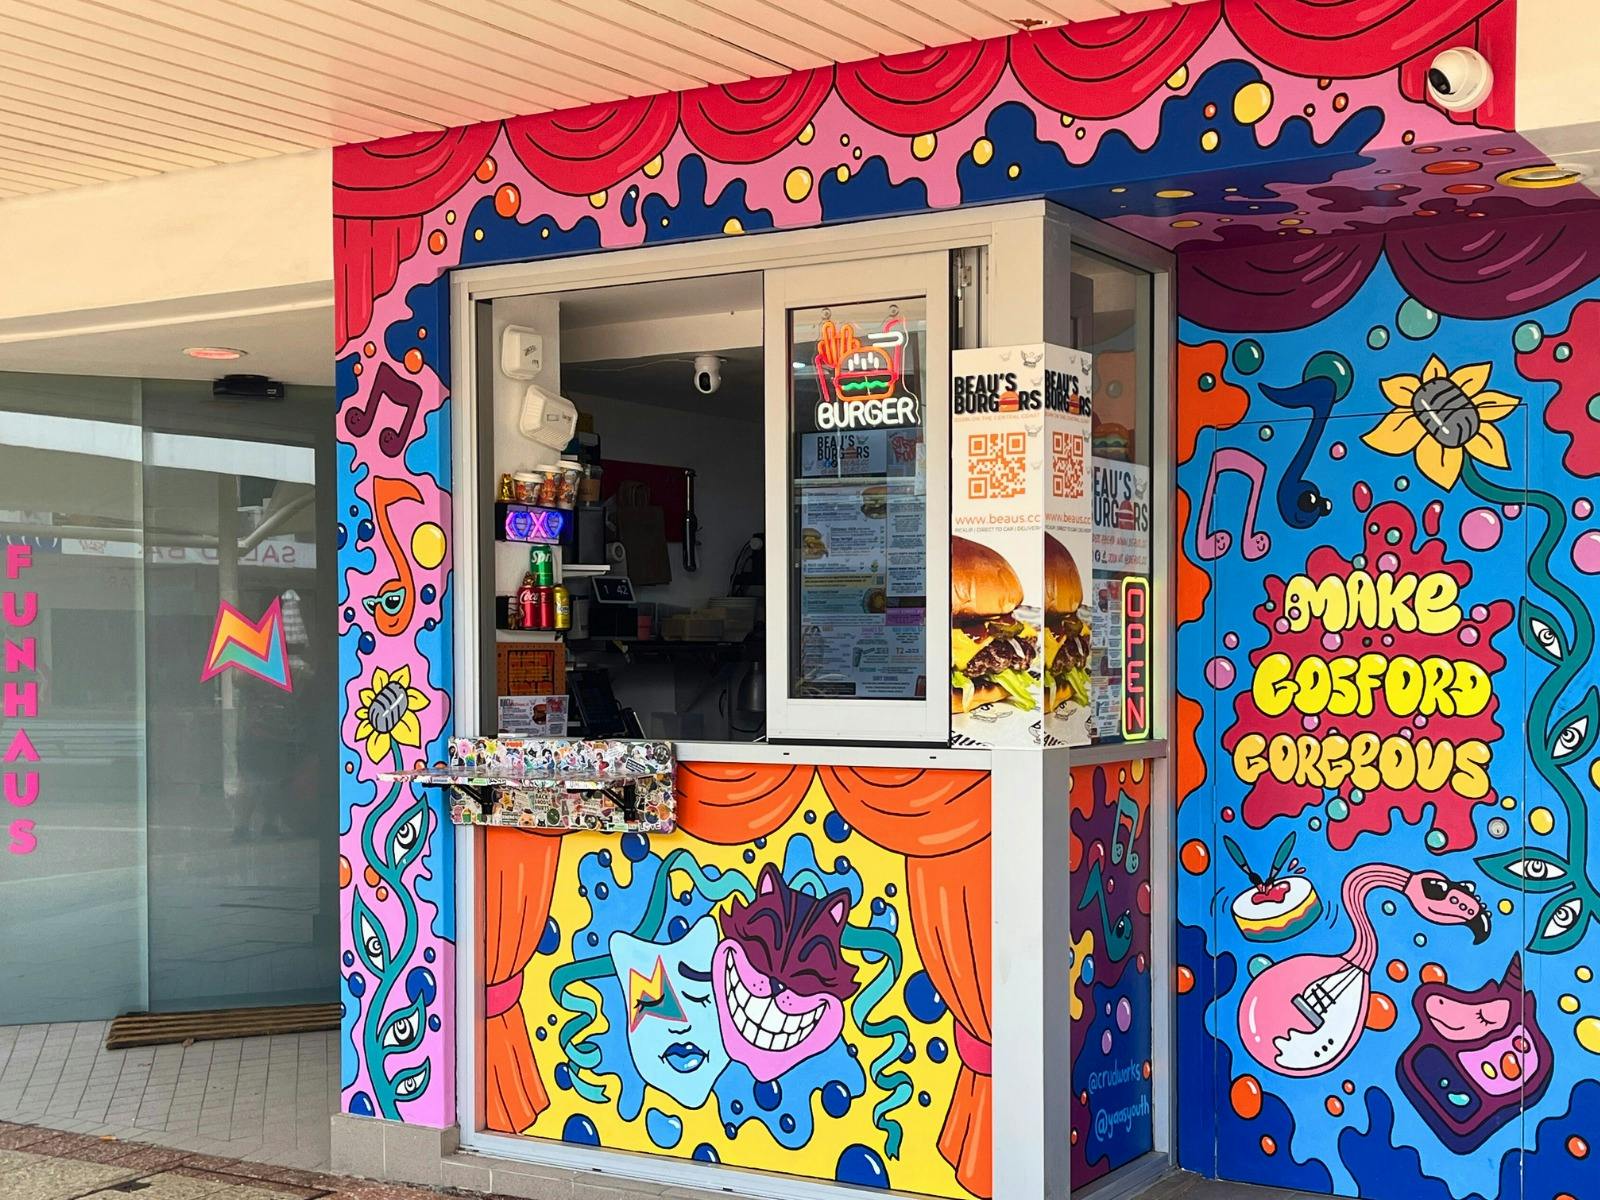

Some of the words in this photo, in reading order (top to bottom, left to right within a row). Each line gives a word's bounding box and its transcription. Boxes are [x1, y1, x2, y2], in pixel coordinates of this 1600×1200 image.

[954, 373, 1018, 395] BEAU'S
[1045, 369, 1079, 394] BEAU'S
[817, 397, 916, 429] BURGER
[954, 390, 1042, 414] BURGRS
[1045, 388, 1091, 417] BURGRS
[817, 446, 870, 461] BURGRS
[1093, 466, 1132, 500] EAU'S
[955, 513, 1041, 525] www.beaus.cc
[1045, 512, 1091, 525] www.beaus.cc
[1093, 497, 1148, 532] URGRS
[1284, 570, 1462, 635] MAKE
[1126, 588, 1144, 730] OPEN
[2, 545, 41, 854] FUNHAUS
[1252, 653, 1493, 718] GOSFORD
[1232, 731, 1493, 799] GORGEOUS
[1088, 1059, 1140, 1095] @crudworks
